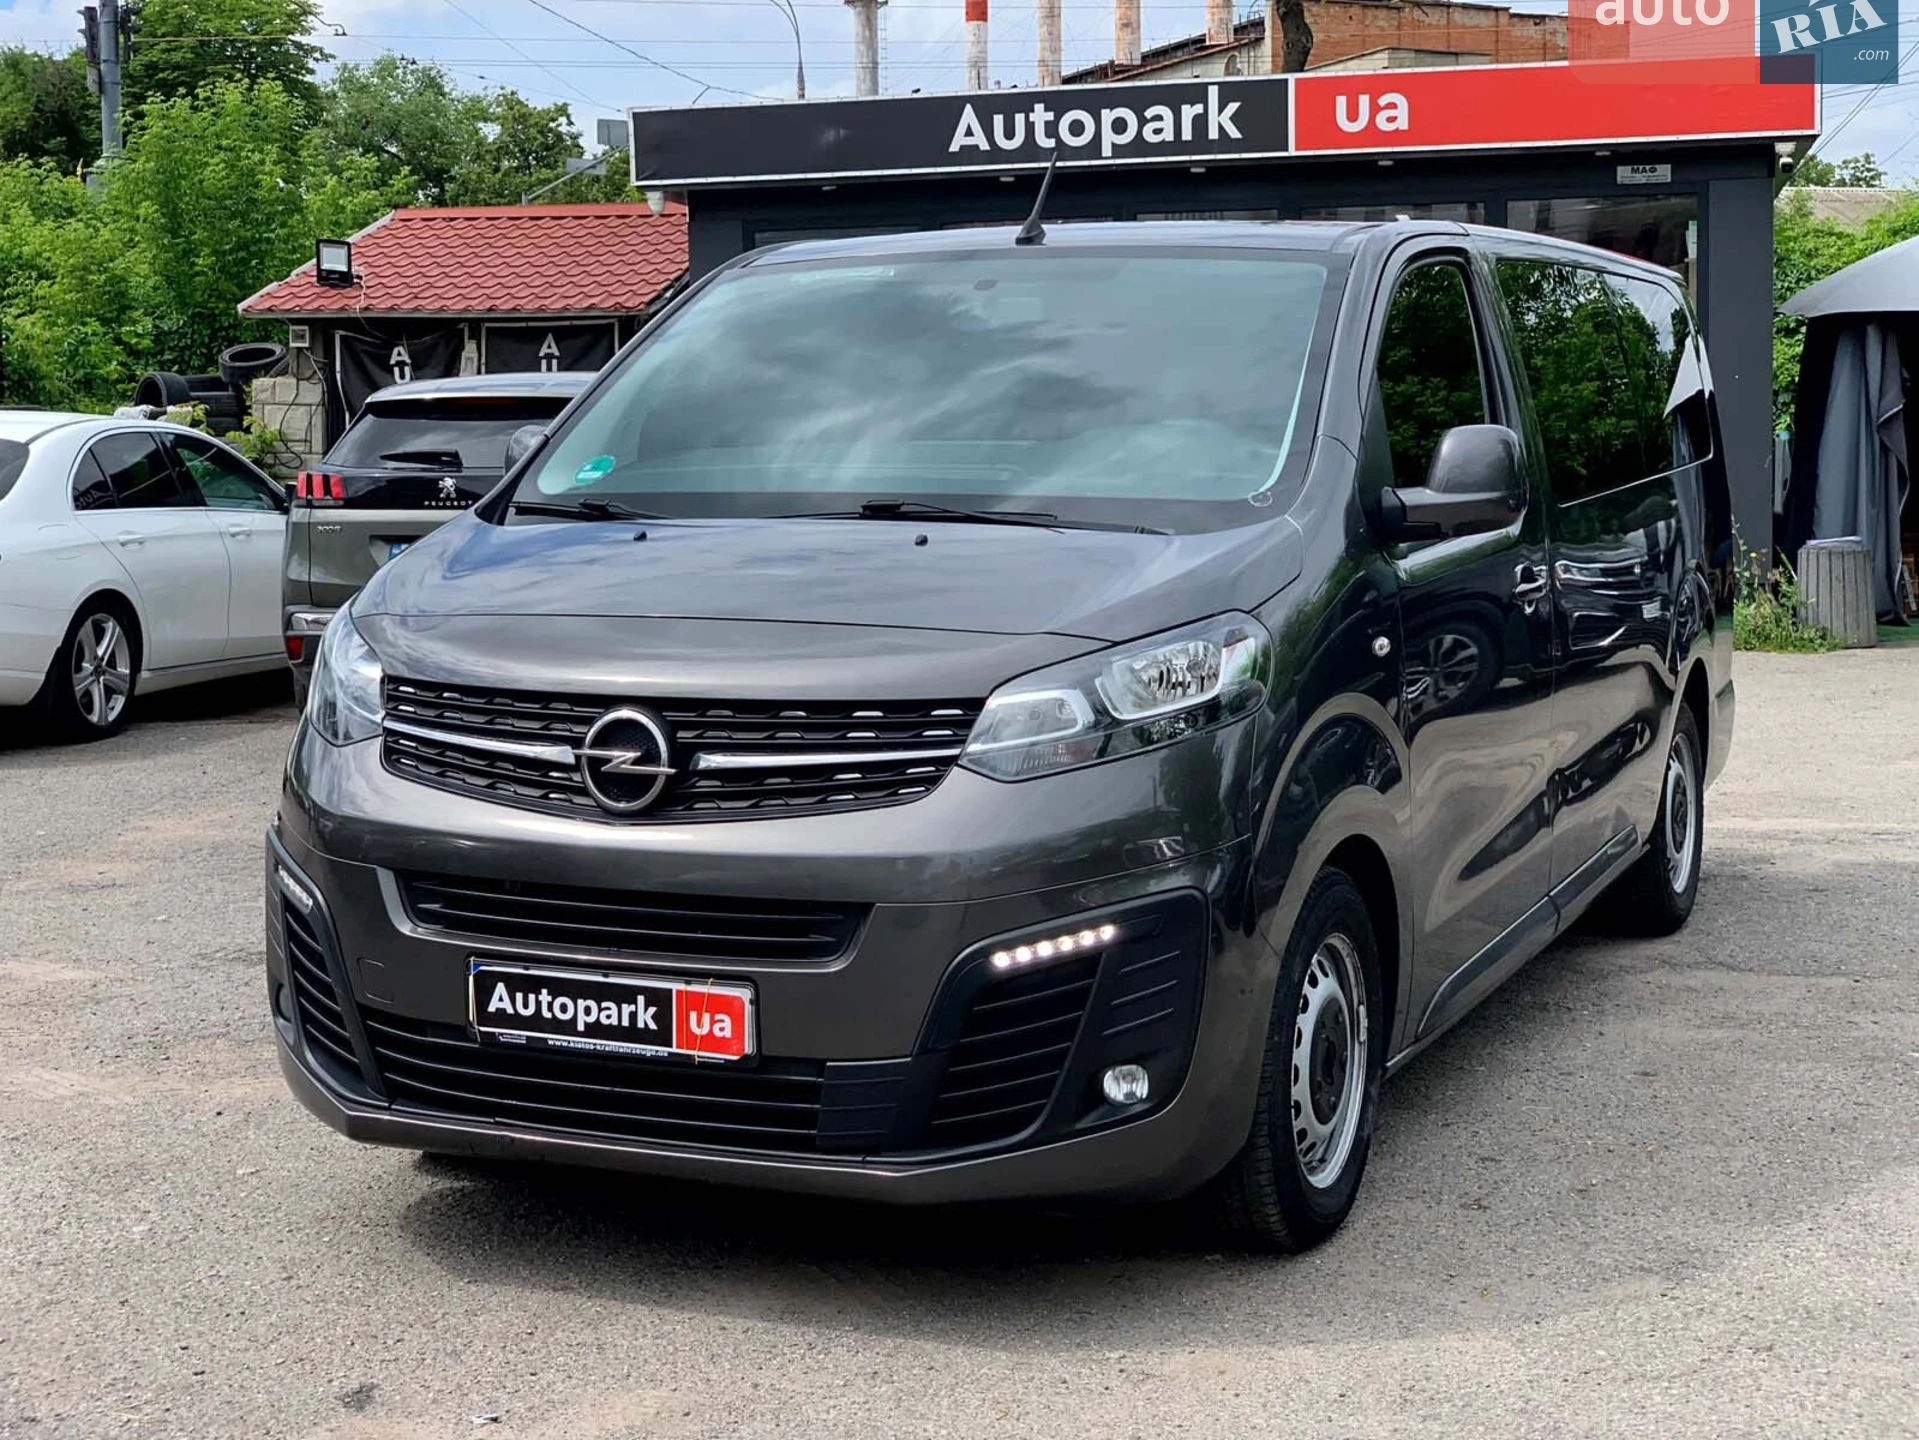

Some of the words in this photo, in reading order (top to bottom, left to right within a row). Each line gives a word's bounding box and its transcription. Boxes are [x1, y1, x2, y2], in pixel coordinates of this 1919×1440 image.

[948, 85, 1244, 157] Autopark
[1334, 91, 1411, 133] ua
[487, 982, 659, 1032] Autopark
[689, 1010, 732, 1038] ua
